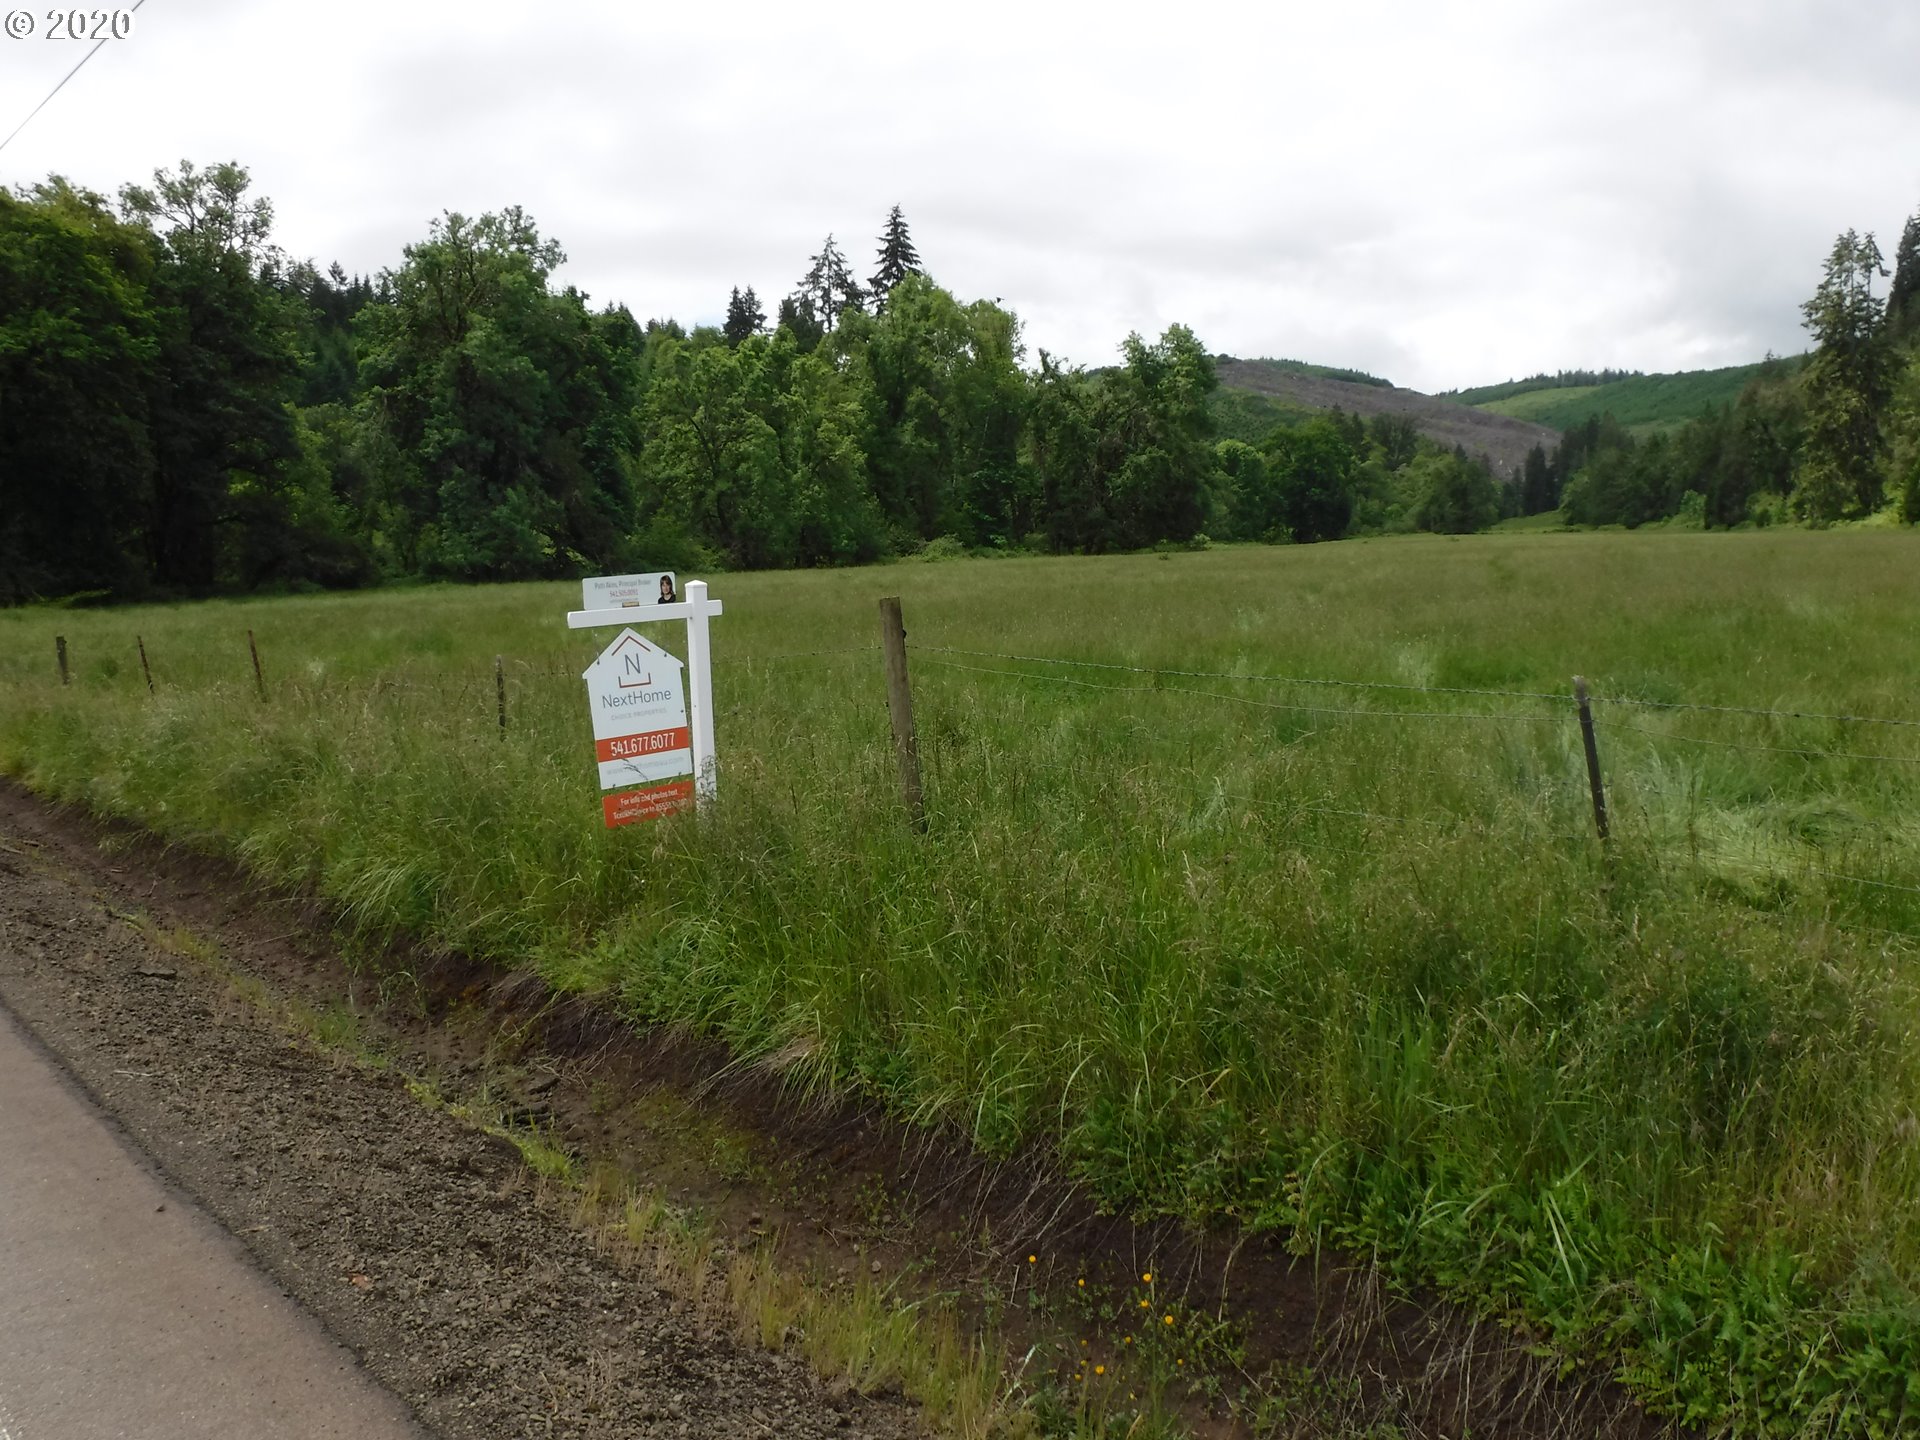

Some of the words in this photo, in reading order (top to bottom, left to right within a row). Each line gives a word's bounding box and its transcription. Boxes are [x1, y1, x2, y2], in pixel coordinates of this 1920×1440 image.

[625, 653, 641, 675] N
[602, 690, 672, 709] NextHome
[610, 732, 675, 757] 541.677.6077
[620, 798, 630, 806] For
